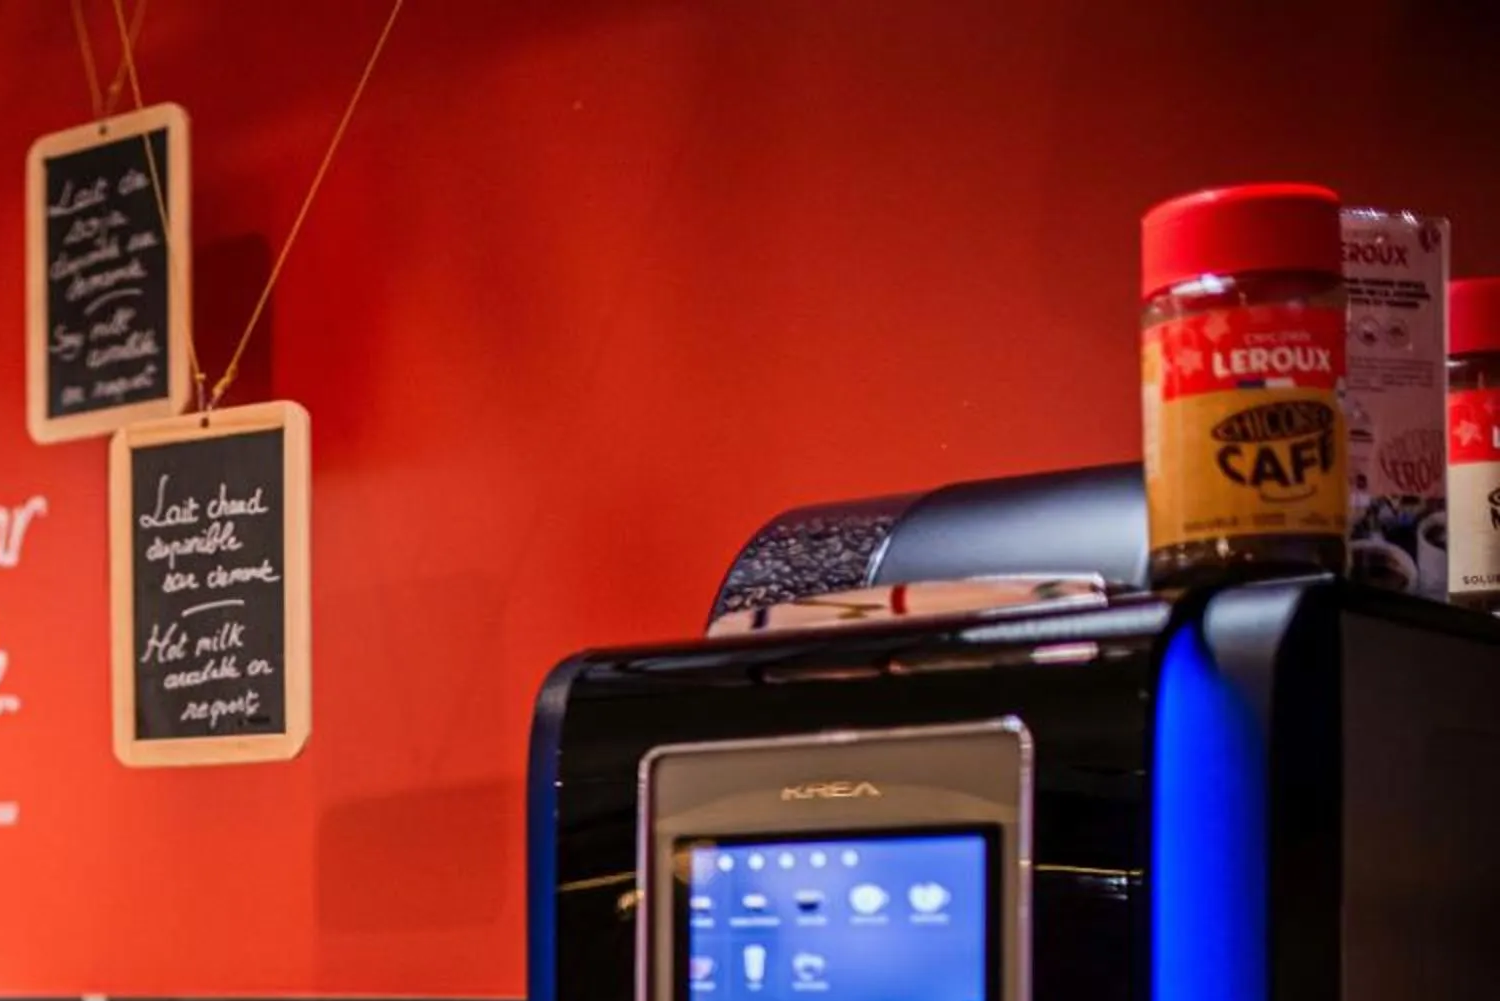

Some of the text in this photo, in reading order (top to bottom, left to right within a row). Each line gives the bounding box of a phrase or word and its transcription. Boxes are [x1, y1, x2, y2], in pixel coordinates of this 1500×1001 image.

[1338, 240, 1408, 268] EROUX
[1211, 345, 1332, 378] LEROUX
[140, 474, 200, 527] Lait
[140, 622, 245, 663] Hot milk
